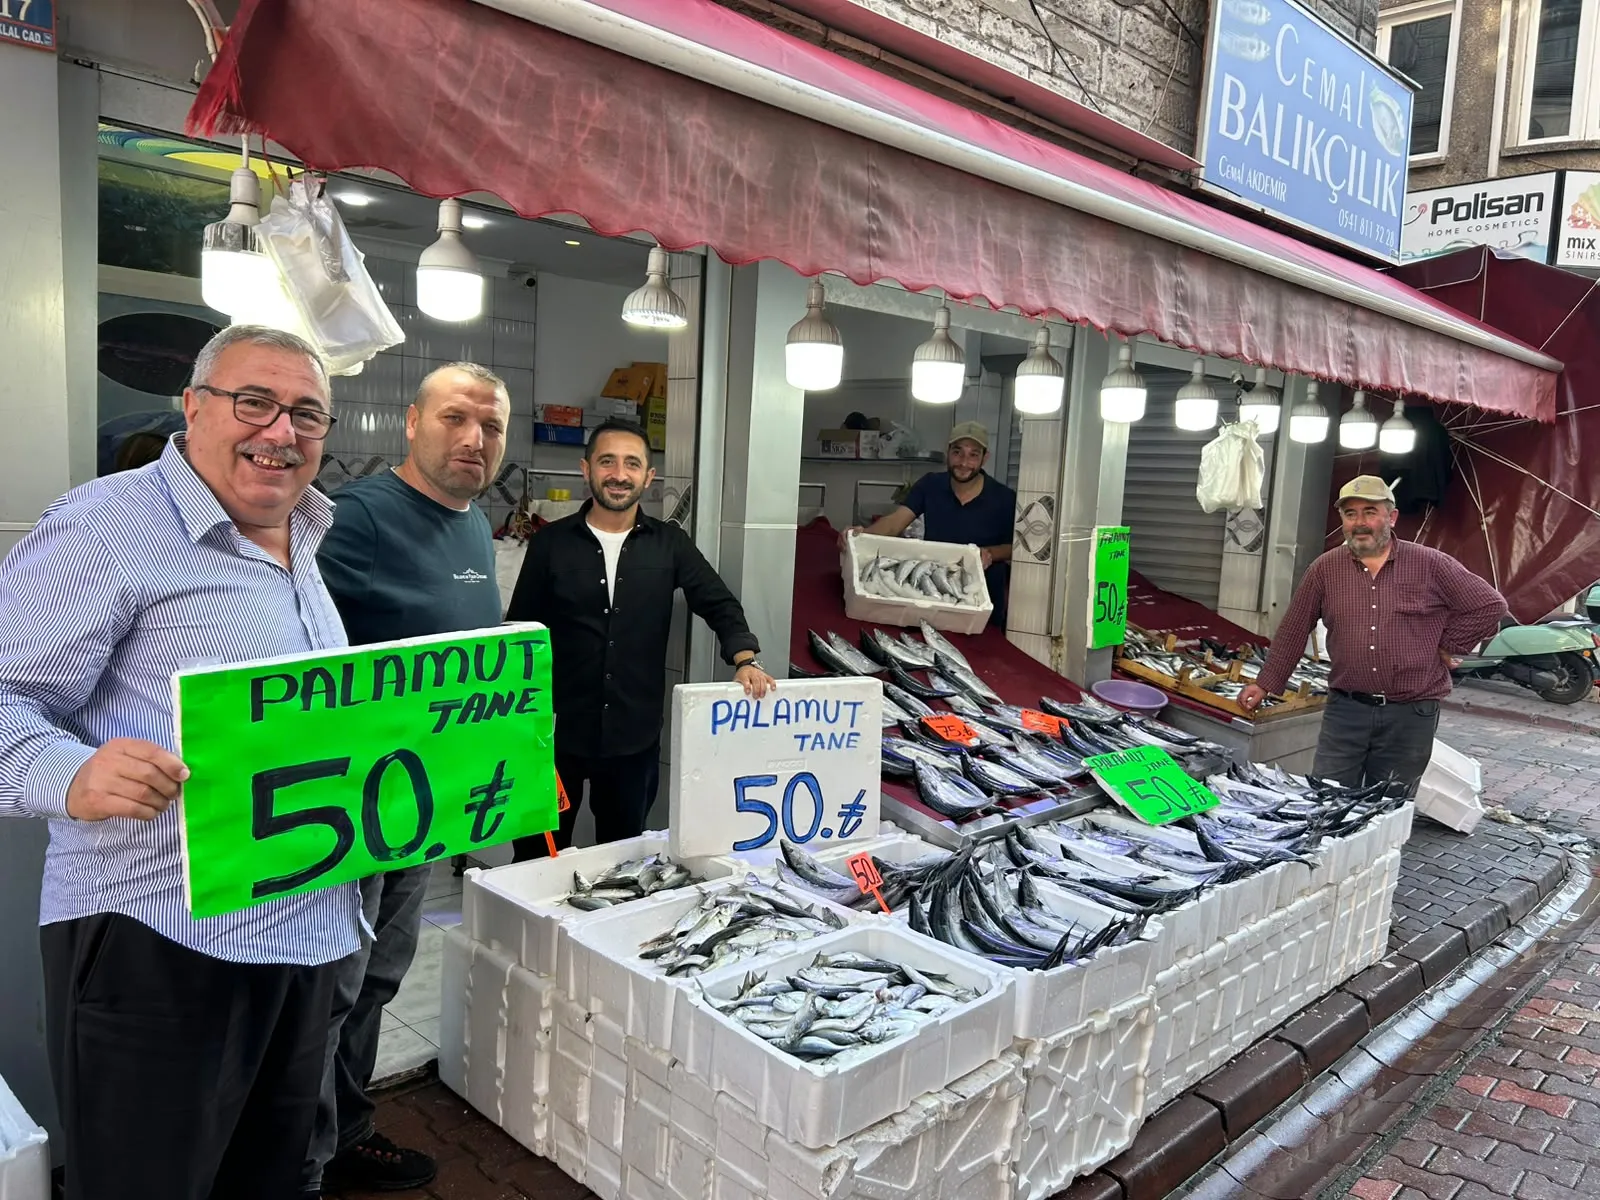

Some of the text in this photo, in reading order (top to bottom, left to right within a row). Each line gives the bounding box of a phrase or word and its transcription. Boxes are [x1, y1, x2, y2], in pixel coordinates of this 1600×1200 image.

[22, 29, 44, 45] CAD.
[1218, 72, 1400, 218] BALIKÇILIK
[1430, 191, 1545, 224] Polisan
[1427, 217, 1540, 238] HOME COSMETICS
[1566, 236, 1597, 250] mix
[250, 639, 548, 723] PALAMUT
[427, 687, 544, 734] TANE
[711, 698, 864, 735] PALAMUT
[793, 732, 862, 752] TANE
[1091, 750, 1146, 772] PALAMUT
